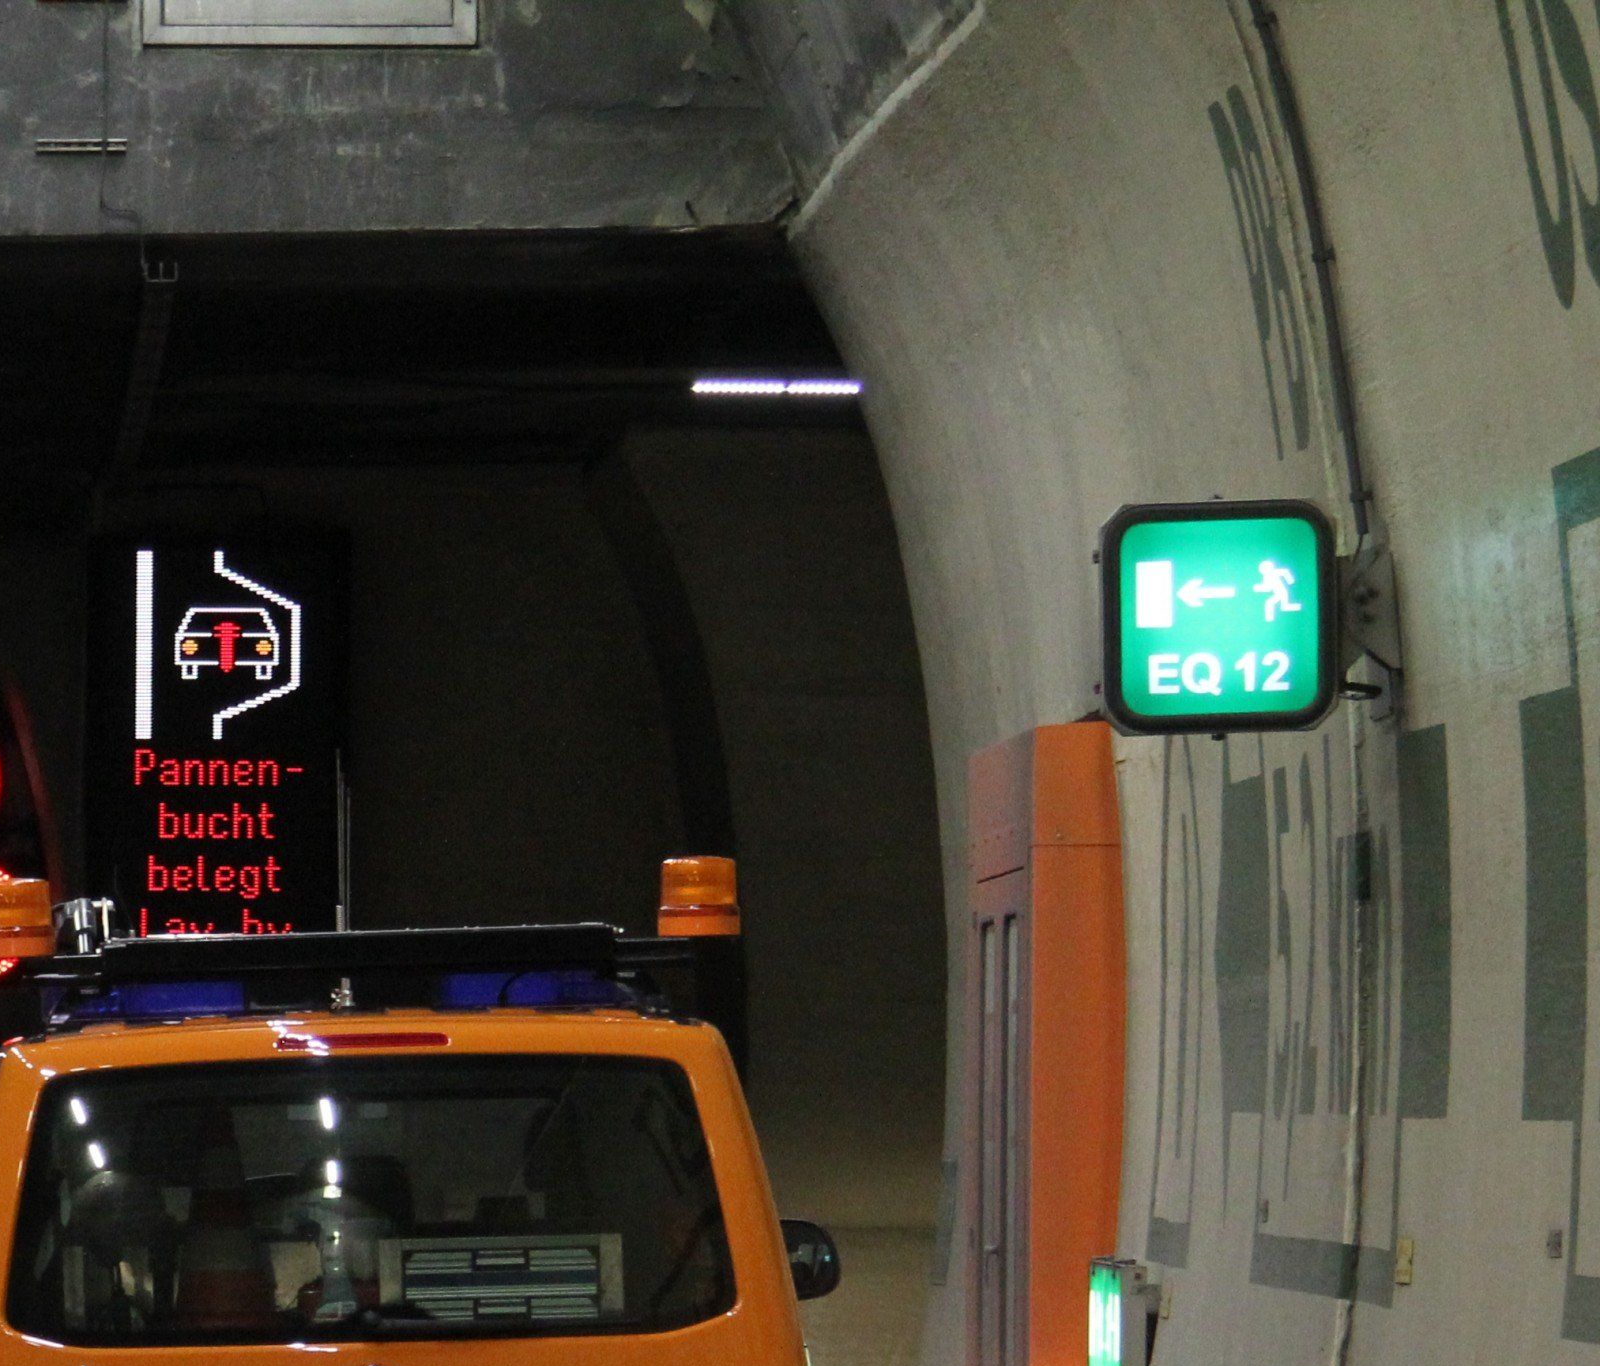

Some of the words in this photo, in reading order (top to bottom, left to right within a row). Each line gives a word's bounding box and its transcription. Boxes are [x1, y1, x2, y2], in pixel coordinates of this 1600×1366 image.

[1148, 652, 1222, 696] EQ
[1234, 650, 1290, 692] 12
[134, 749, 304, 786] Pannen-
[158, 802, 276, 839] bucht
[147, 855, 282, 899] belegt
